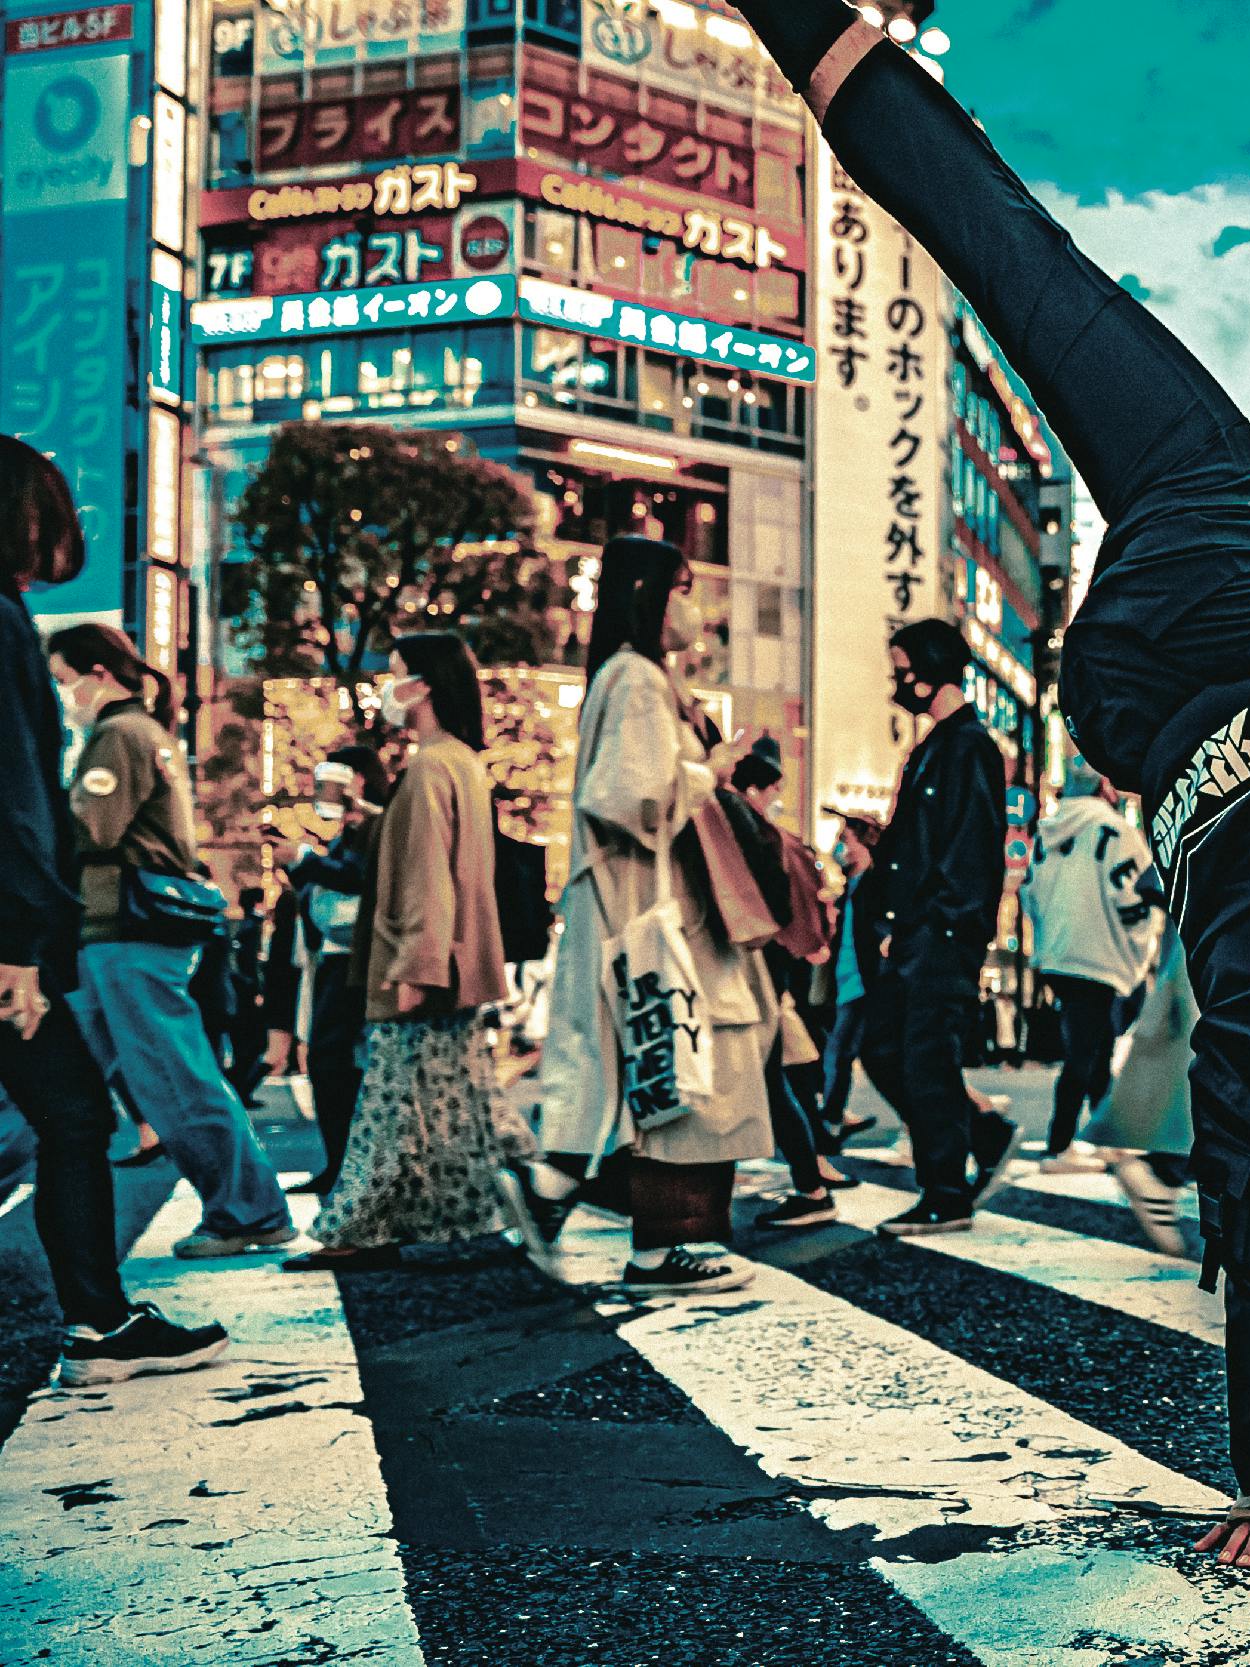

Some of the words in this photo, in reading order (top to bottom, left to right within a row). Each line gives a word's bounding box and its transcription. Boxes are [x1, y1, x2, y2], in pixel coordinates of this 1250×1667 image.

[523, 88, 750, 190] コンタクト
[374, 161, 477, 215] ガスト
[321, 229, 444, 290] ガスト
[683, 209, 787, 268] ガスト
[207, 252, 250, 290] 7F
[13, 263, 66, 460] アイシ
